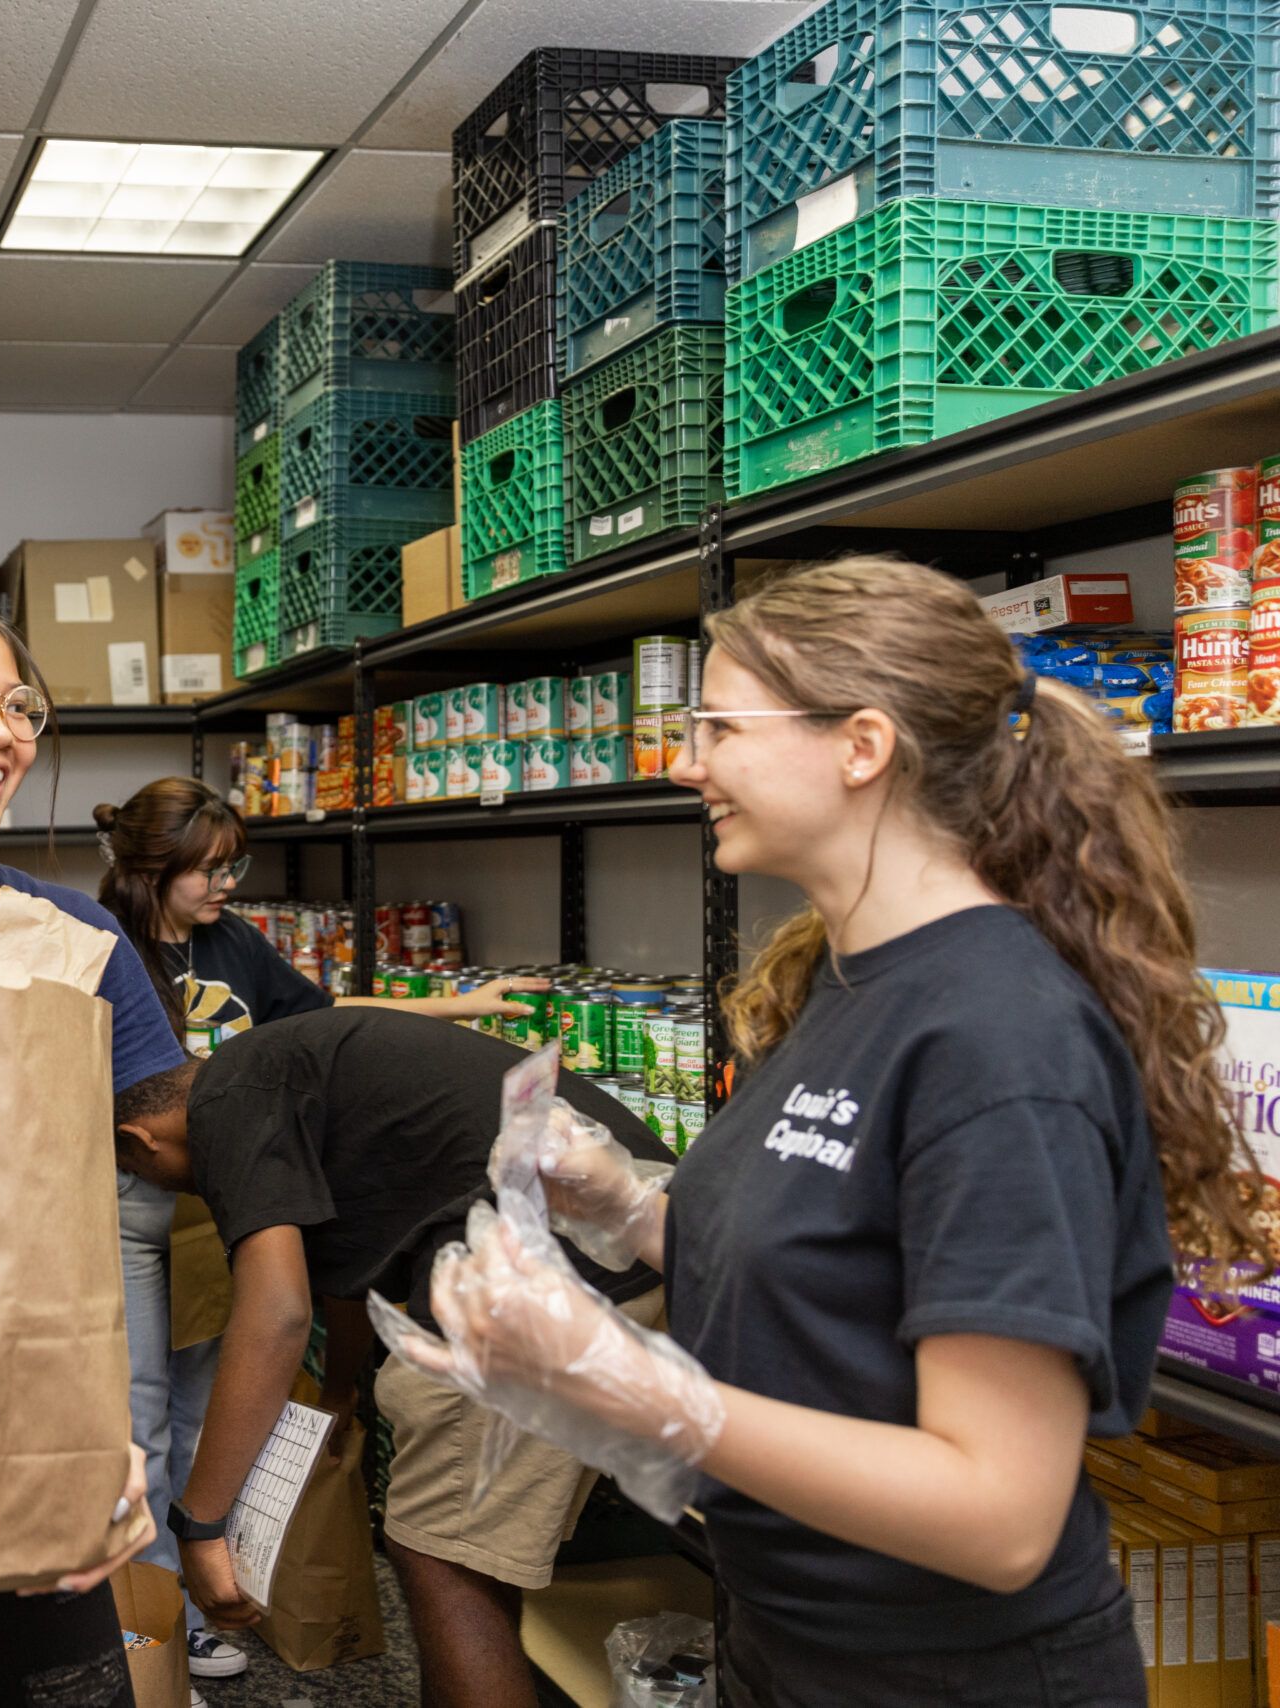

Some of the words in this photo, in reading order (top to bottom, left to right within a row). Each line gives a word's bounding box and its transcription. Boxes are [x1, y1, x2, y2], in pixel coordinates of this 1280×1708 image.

[1173, 501, 1220, 526] unt's
[990, 600, 1031, 619] Lasag
[1194, 620, 1239, 630] PREMIUM
[1187, 658, 1213, 668] PASTA
[1215, 656, 1247, 666] SAUCE
[1187, 680, 1209, 689] Four
[1218, 1059, 1253, 1084] ulti
